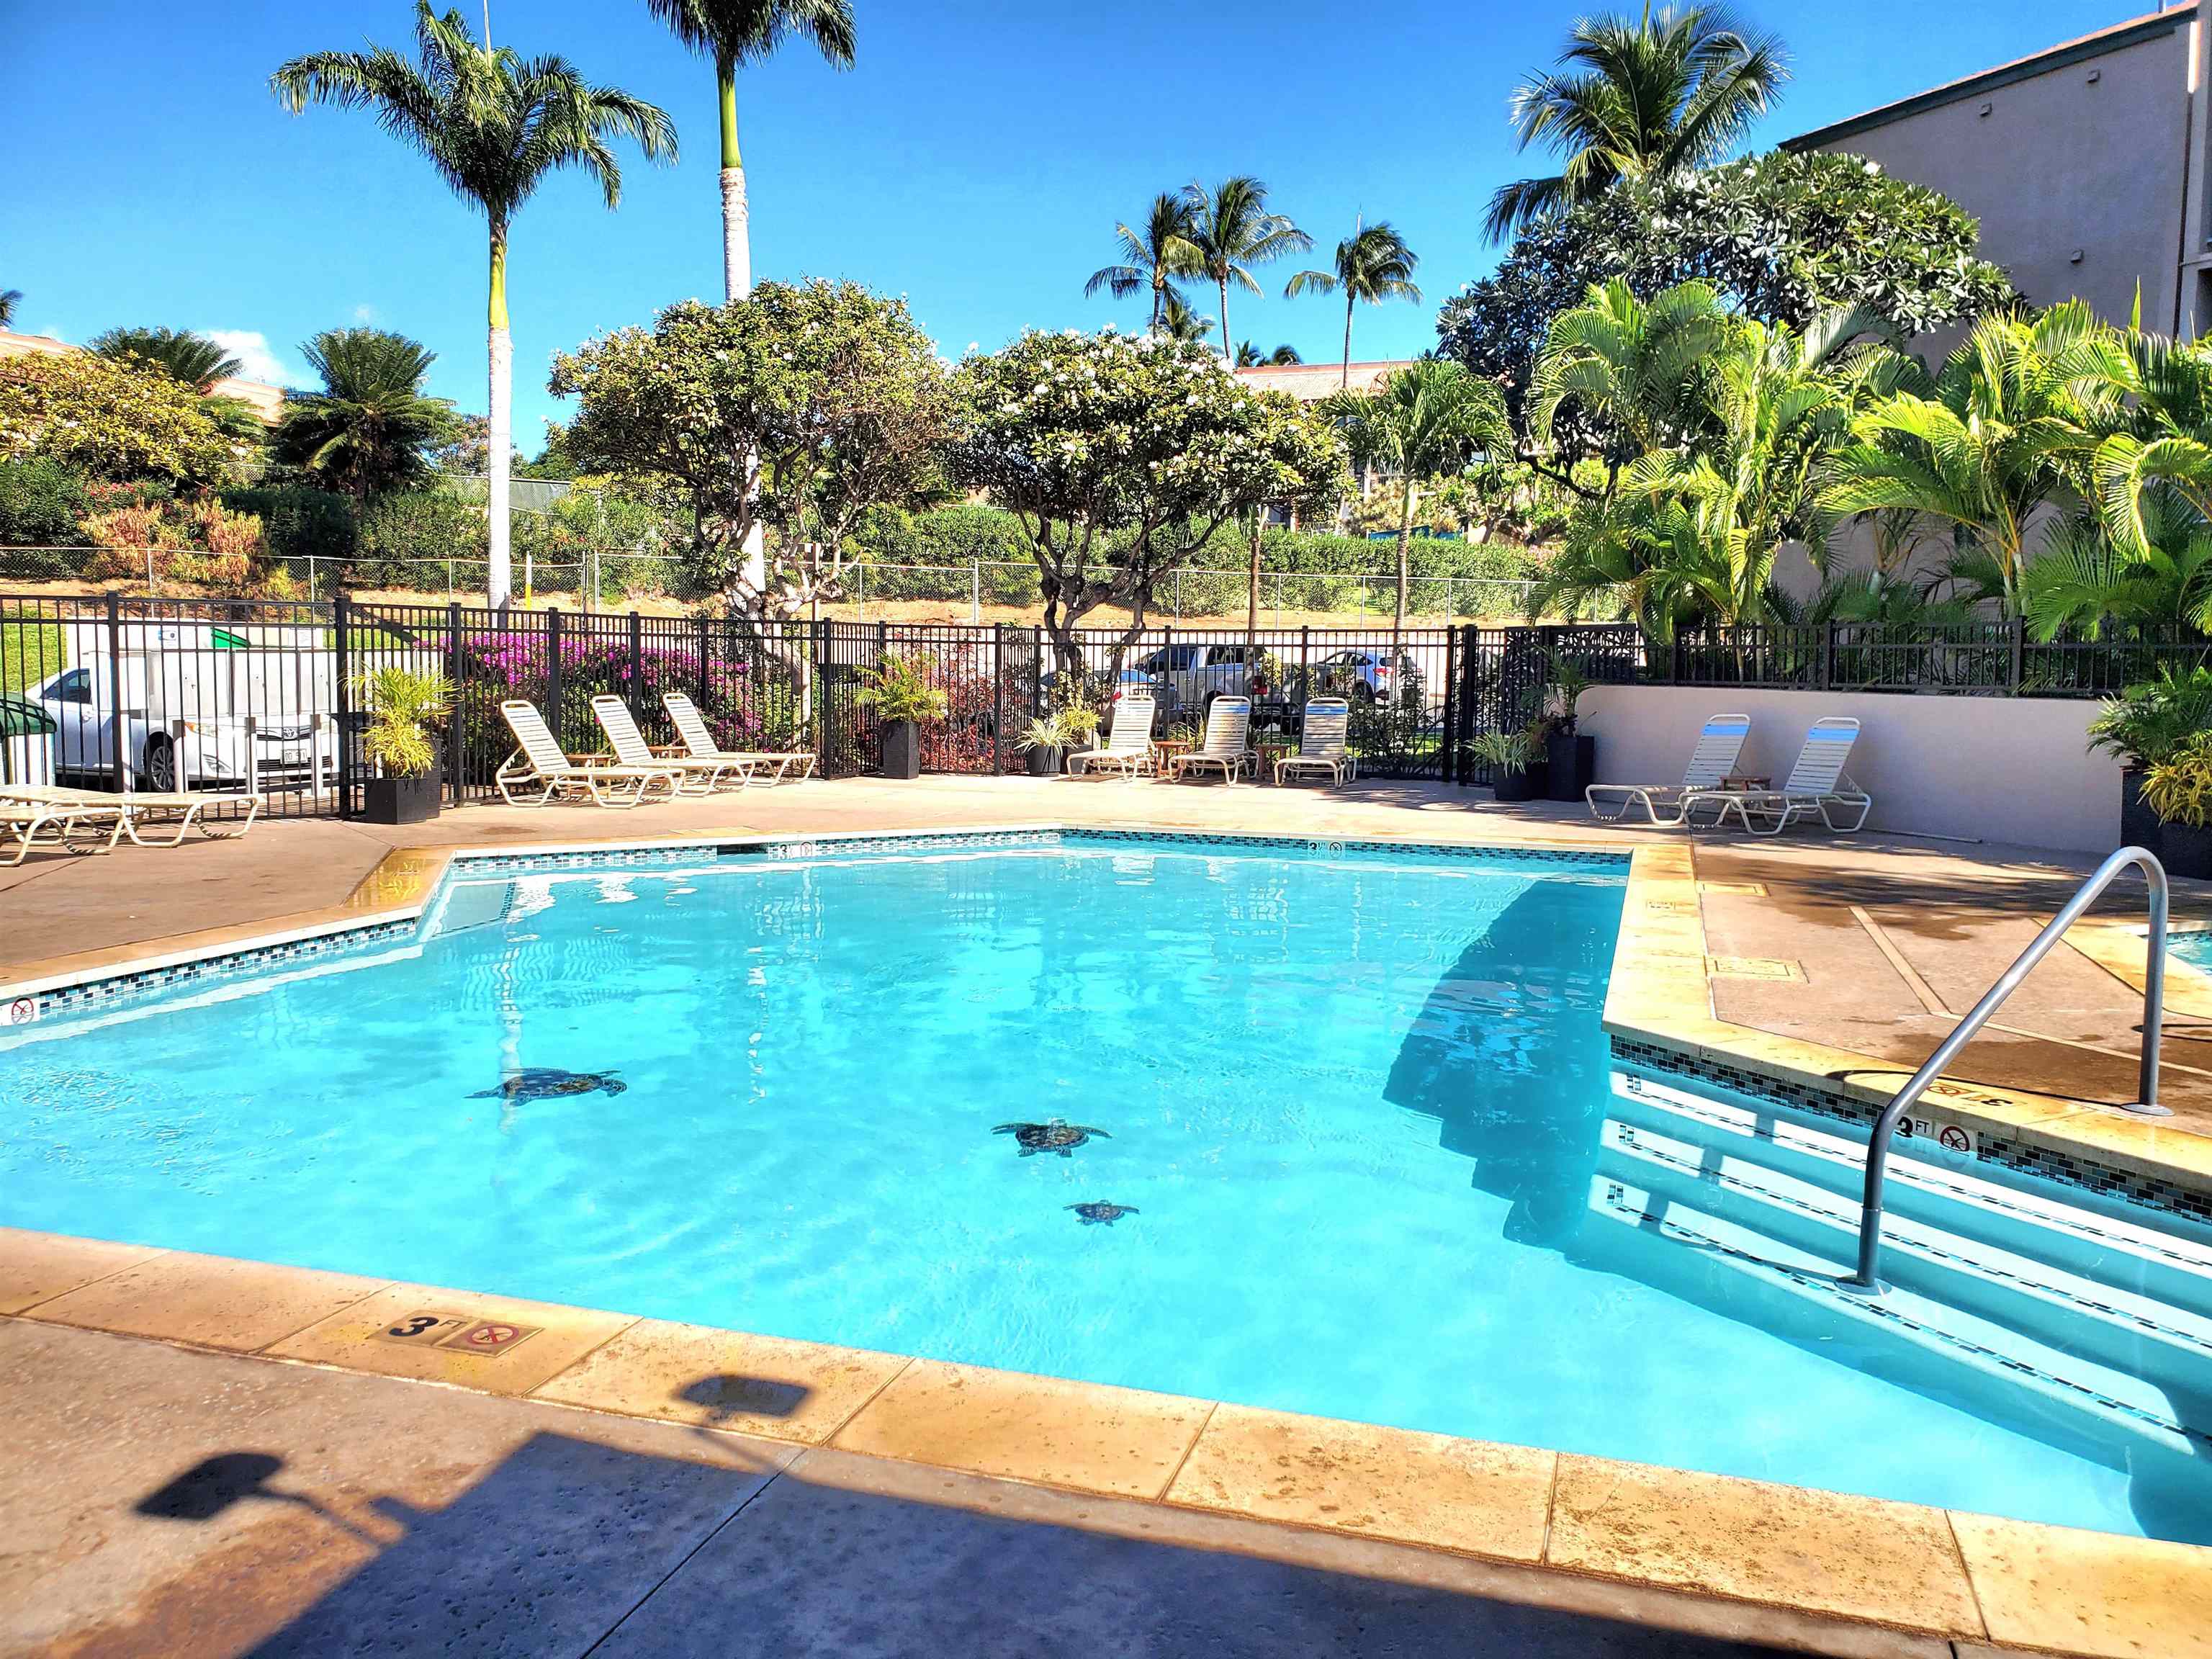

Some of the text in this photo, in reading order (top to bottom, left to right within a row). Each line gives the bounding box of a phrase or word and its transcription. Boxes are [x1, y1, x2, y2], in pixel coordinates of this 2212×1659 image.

[1915, 1120, 1930, 1134] FT
[389, 1316, 468, 1337] 3 FT
